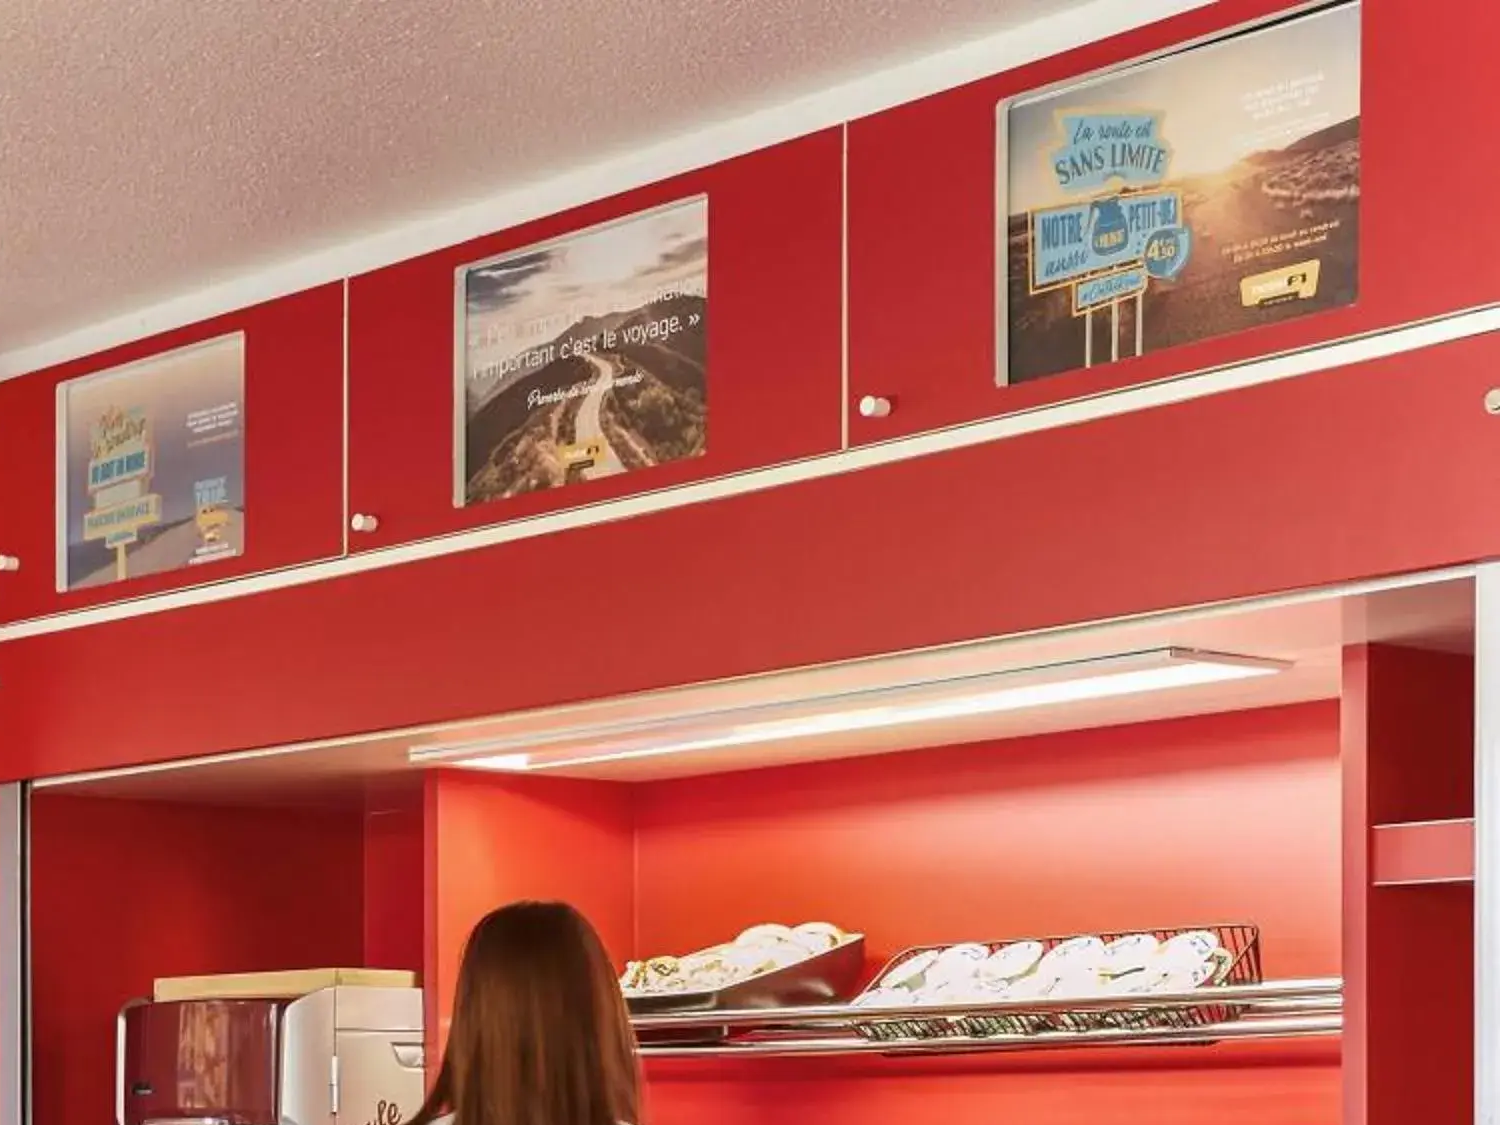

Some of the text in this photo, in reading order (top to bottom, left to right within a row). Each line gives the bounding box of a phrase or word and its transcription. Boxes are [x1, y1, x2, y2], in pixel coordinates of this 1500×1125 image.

[1055, 143, 1166, 185] SANS LIMITE
[1041, 212, 1083, 249] NOTRE
[560, 337, 597, 360] c'est
[602, 328, 617, 350] le
